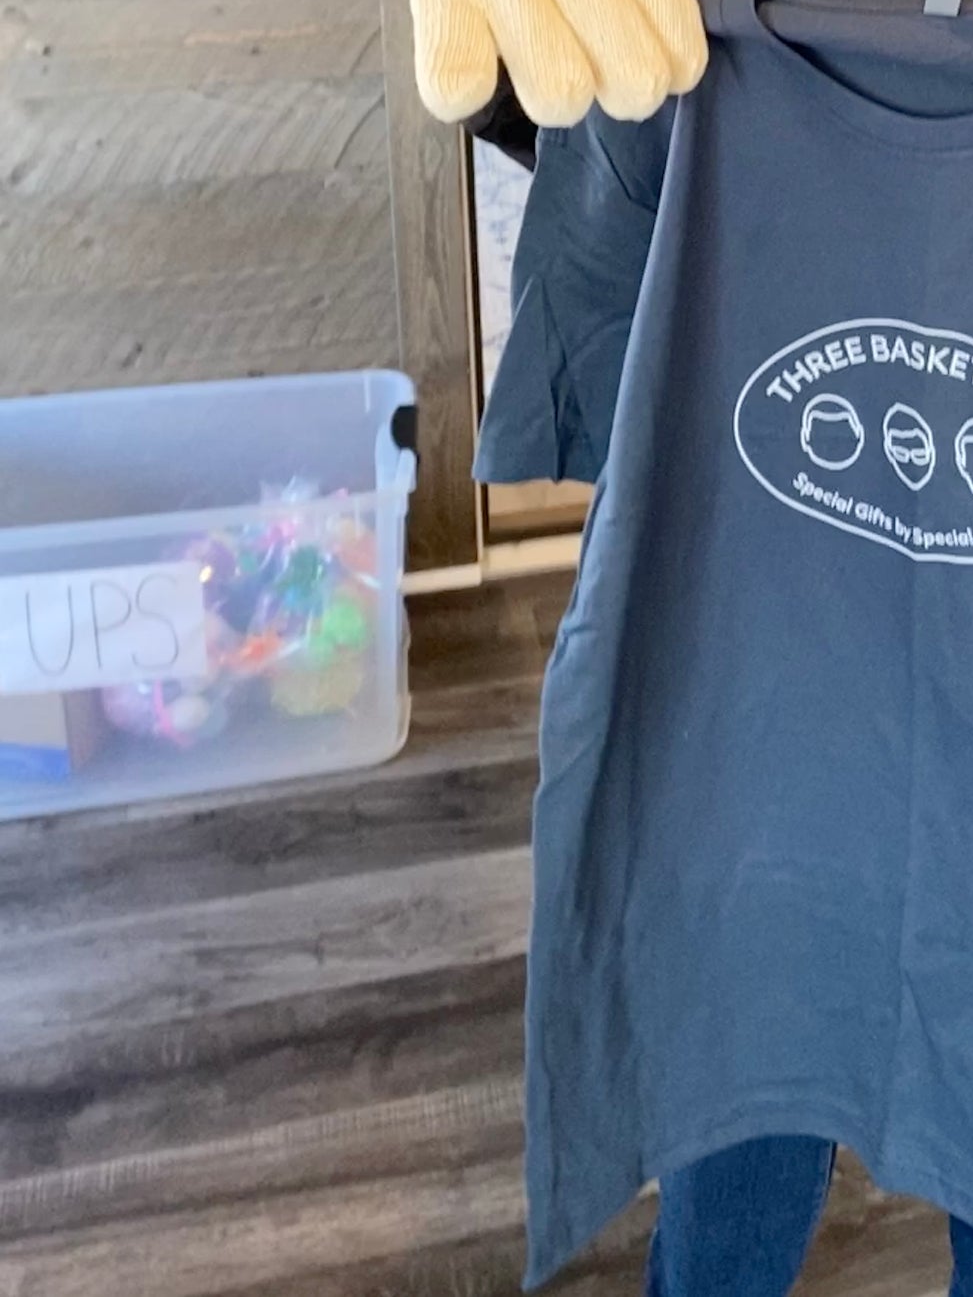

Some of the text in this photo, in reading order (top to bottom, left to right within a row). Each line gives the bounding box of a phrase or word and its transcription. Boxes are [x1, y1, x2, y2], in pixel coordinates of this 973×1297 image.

[766, 335, 867, 403] THREE
[793, 472, 853, 515] Special
[855, 502, 893, 531] Gifts
[895, 516, 911, 544] by
[912, 526, 973, 550] Special
[25, 573, 181, 677] UPS
